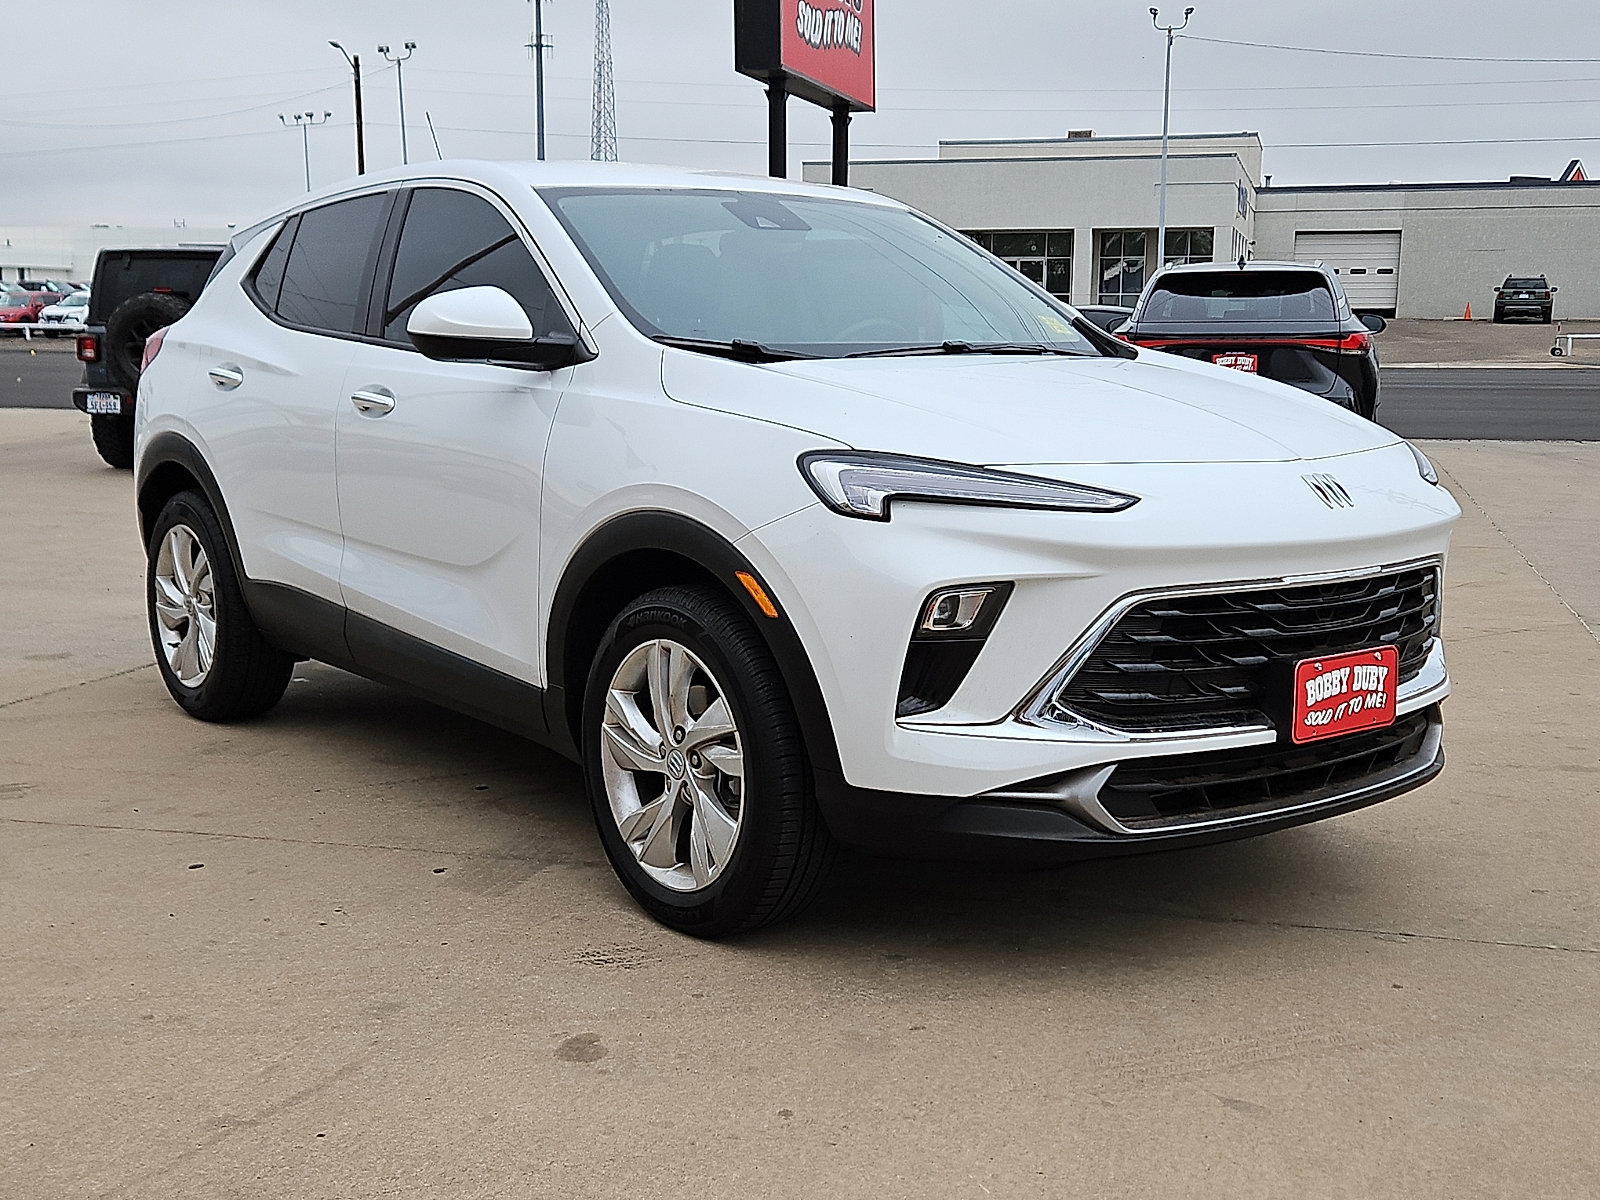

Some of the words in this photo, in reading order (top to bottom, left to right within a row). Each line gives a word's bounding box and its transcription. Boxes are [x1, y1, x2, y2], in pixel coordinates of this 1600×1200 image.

[797, 0, 823, 48] SOLD
[823, 9, 833, 48] IT
[833, 8, 845, 48] TO
[1305, 667, 1351, 707] BOBBY
[1352, 665, 1389, 692] DUBY
[1304, 708, 1334, 726] SOLD
[1348, 695, 1363, 716] TO
[1363, 692, 1387, 710] ME!
